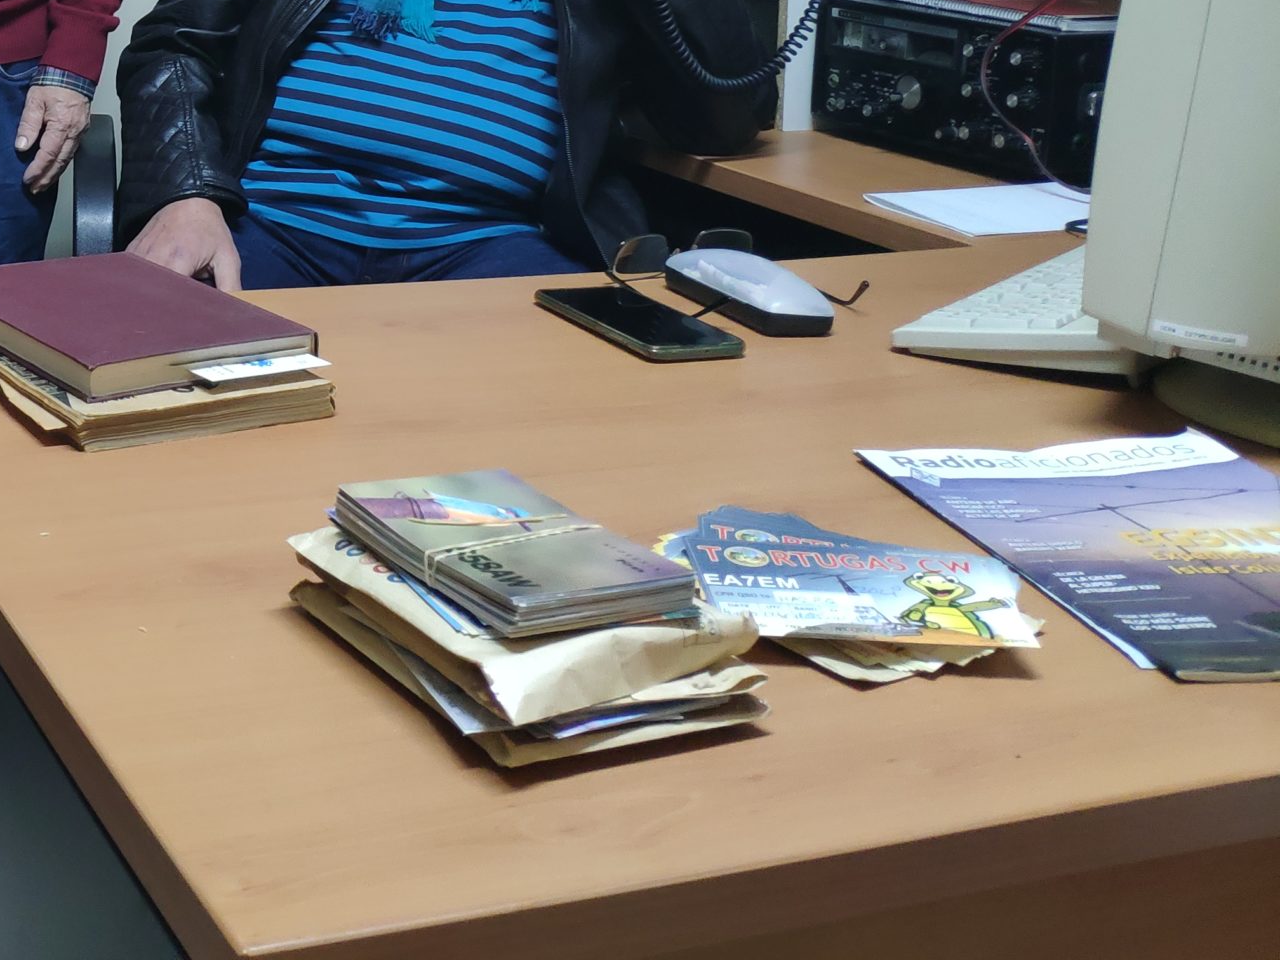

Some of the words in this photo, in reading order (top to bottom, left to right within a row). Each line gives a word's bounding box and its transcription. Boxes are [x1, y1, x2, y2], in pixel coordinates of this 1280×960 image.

[889, 444, 1196, 469] Radioaficionados
[696, 544, 909, 573] TORTUGAS
[918, 558, 971, 574] CW
[703, 573, 800, 589] EA7EM
